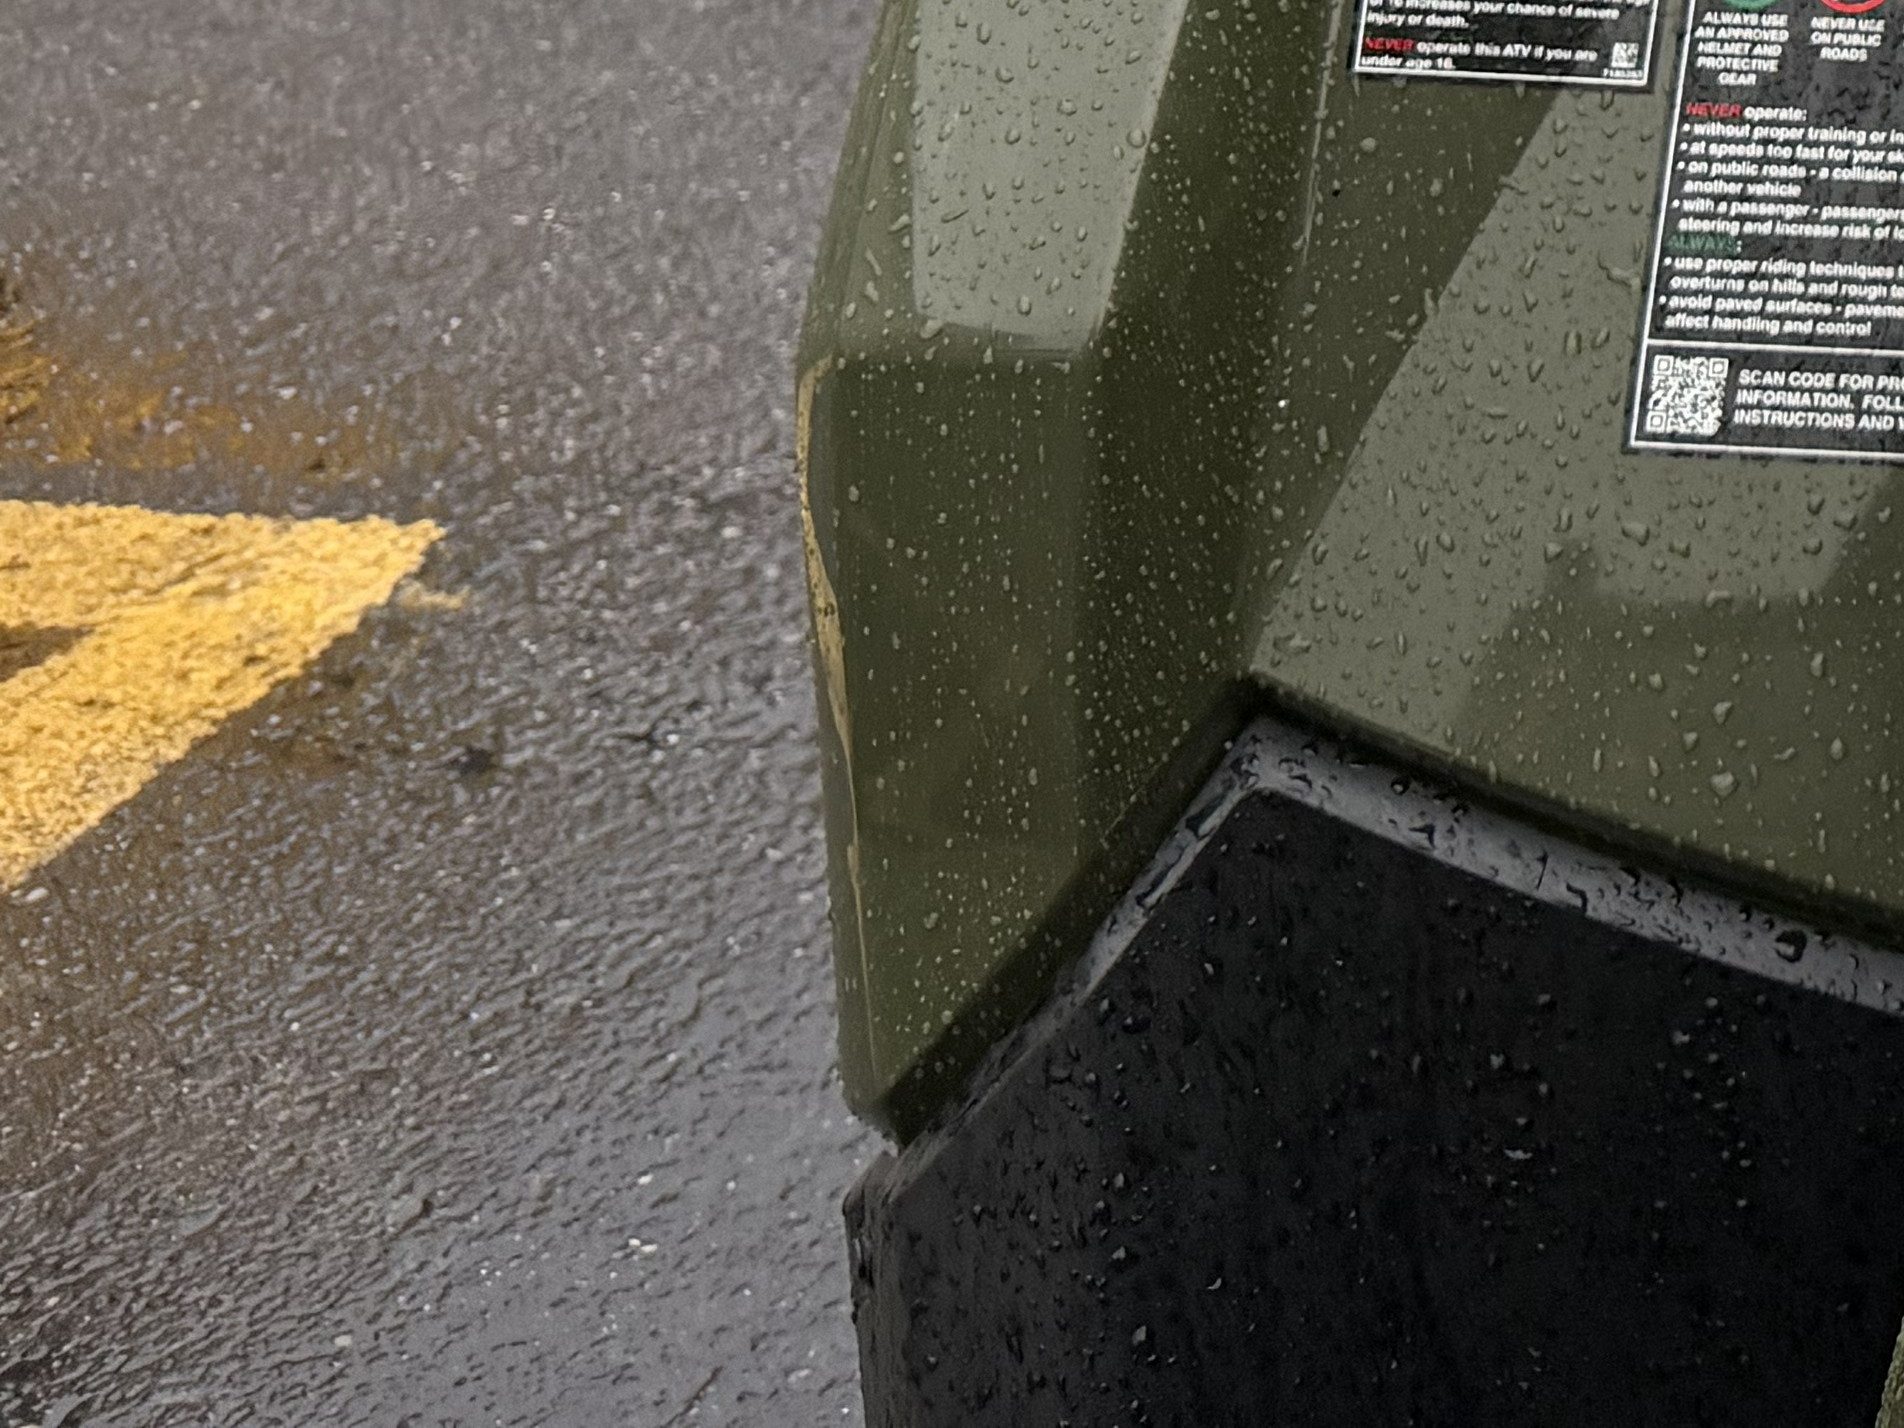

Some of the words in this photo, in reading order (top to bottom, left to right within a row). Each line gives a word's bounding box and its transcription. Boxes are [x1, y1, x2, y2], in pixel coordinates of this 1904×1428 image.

[1366, 11, 1405, 26] injury
[1406, 16, 1422, 25] or
[1424, 14, 1469, 27] death.
[1471, 2, 1504, 15] your
[1505, 1, 1556, 15] chance
[1557, 4, 1573, 16] of
[1574, 7, 1619, 18] severe
[1414, 39, 1471, 55] operate
[1472, 42, 1501, 54] this
[1502, 44, 1531, 56] ATV
[1532, 45, 1544, 56] if
[1544, 48, 1571, 61] you
[1573, 50, 1598, 59] are
[1361, 53, 1402, 65] under
[1403, 58, 1432, 69] age
[1742, 105, 1807, 123] operate:
[1693, 121, 1750, 136] without
[1751, 127, 1804, 141] proper
[1805, 126, 1867, 144] training
[1868, 132, 1886, 142] or
[1690, 139, 1706, 152] at
[1707, 140, 1764, 158] speeds
[1765, 143, 1793, 156] too
[1794, 144, 1825, 158] fast
[1826, 146, 1850, 159] for
[1851, 150, 1885, 164] your
[1683, 178, 1743, 193] another
[1744, 181, 1801, 196] vehicle
[1738, 368, 1786, 386] SCAN
[1786, 370, 1836, 389] CODE
[1836, 373, 1874, 390] FOR
[1736, 388, 1856, 409] INFORMATION.
[1733, 408, 1856, 429] INSTRUCTIONS
[1856, 413, 1895, 431] AND
